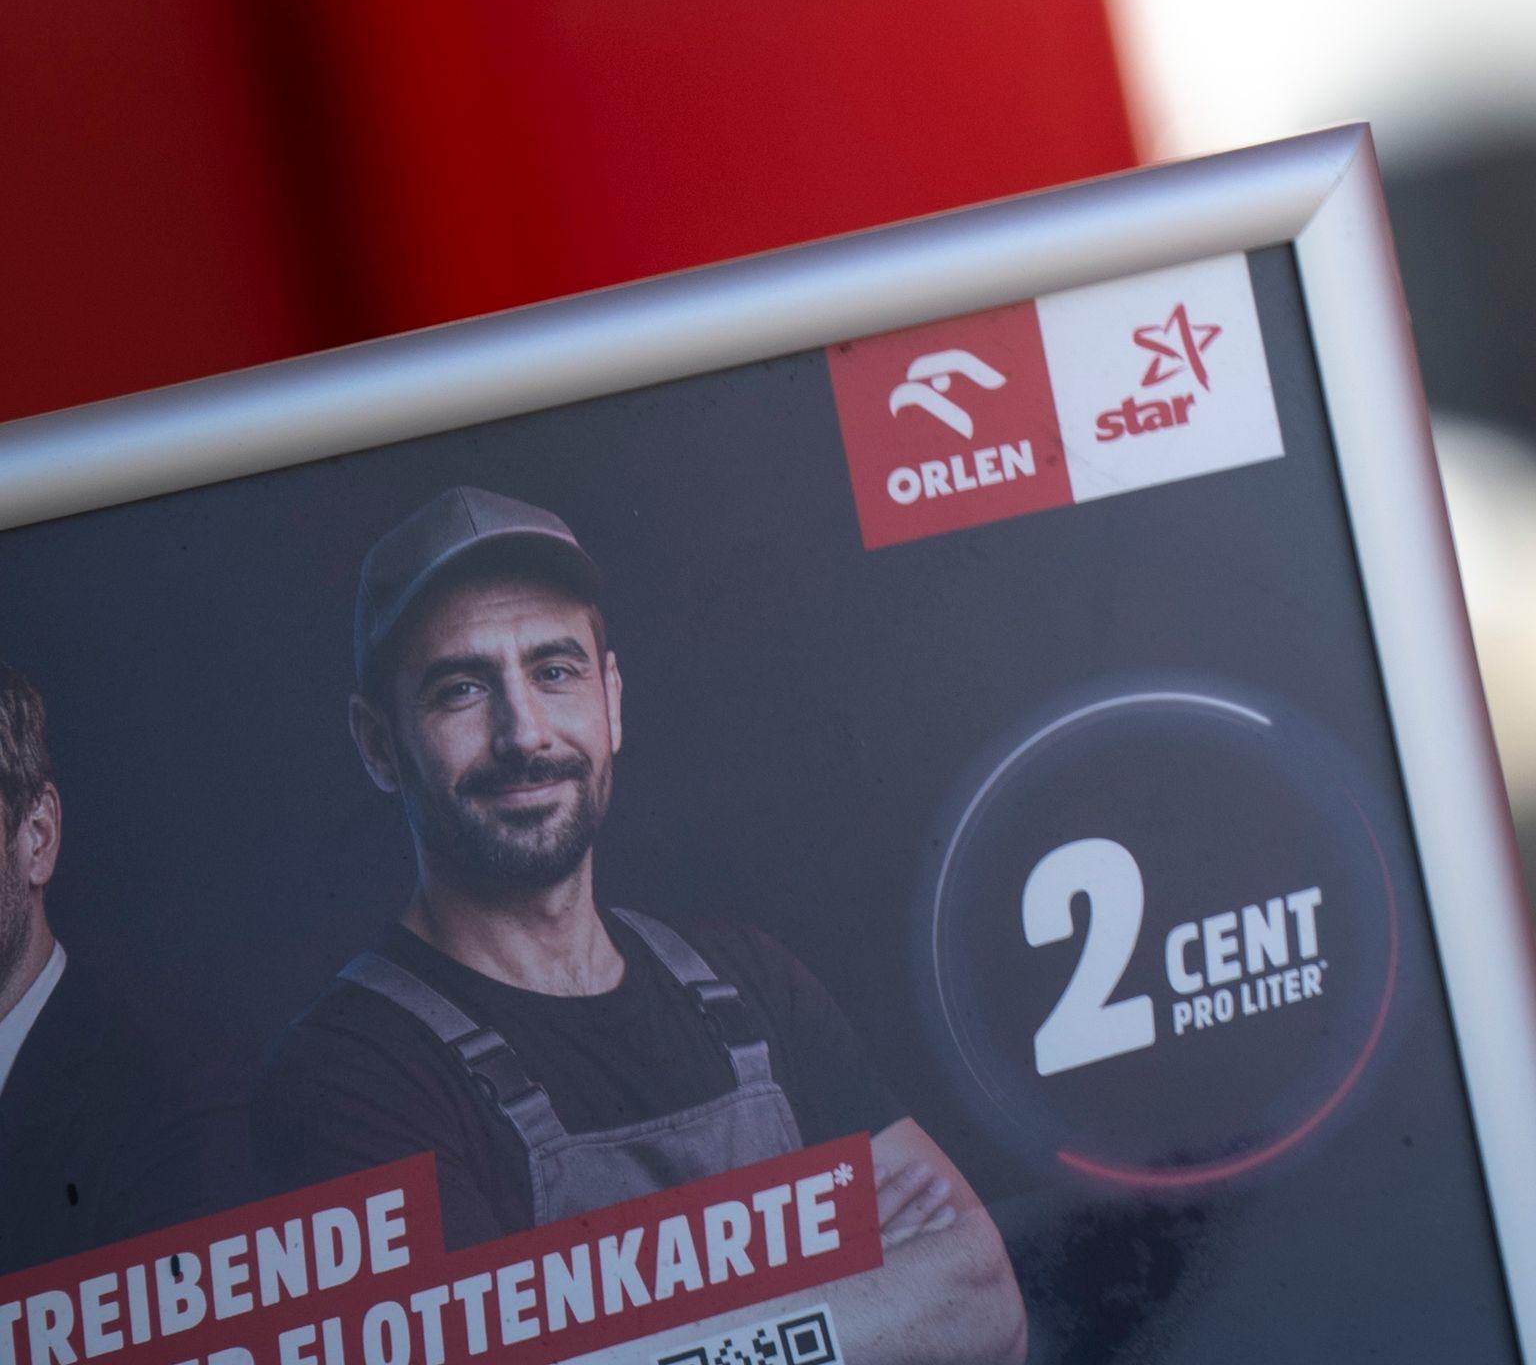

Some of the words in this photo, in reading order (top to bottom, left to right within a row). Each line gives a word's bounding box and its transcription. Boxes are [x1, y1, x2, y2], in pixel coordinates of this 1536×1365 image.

[1095, 392, 1196, 443] star
[887, 440, 1036, 505] ORLEN
[1022, 837, 1156, 1077] 2
[1165, 886, 1322, 995] CENT
[1172, 989, 1235, 1037] PRO
